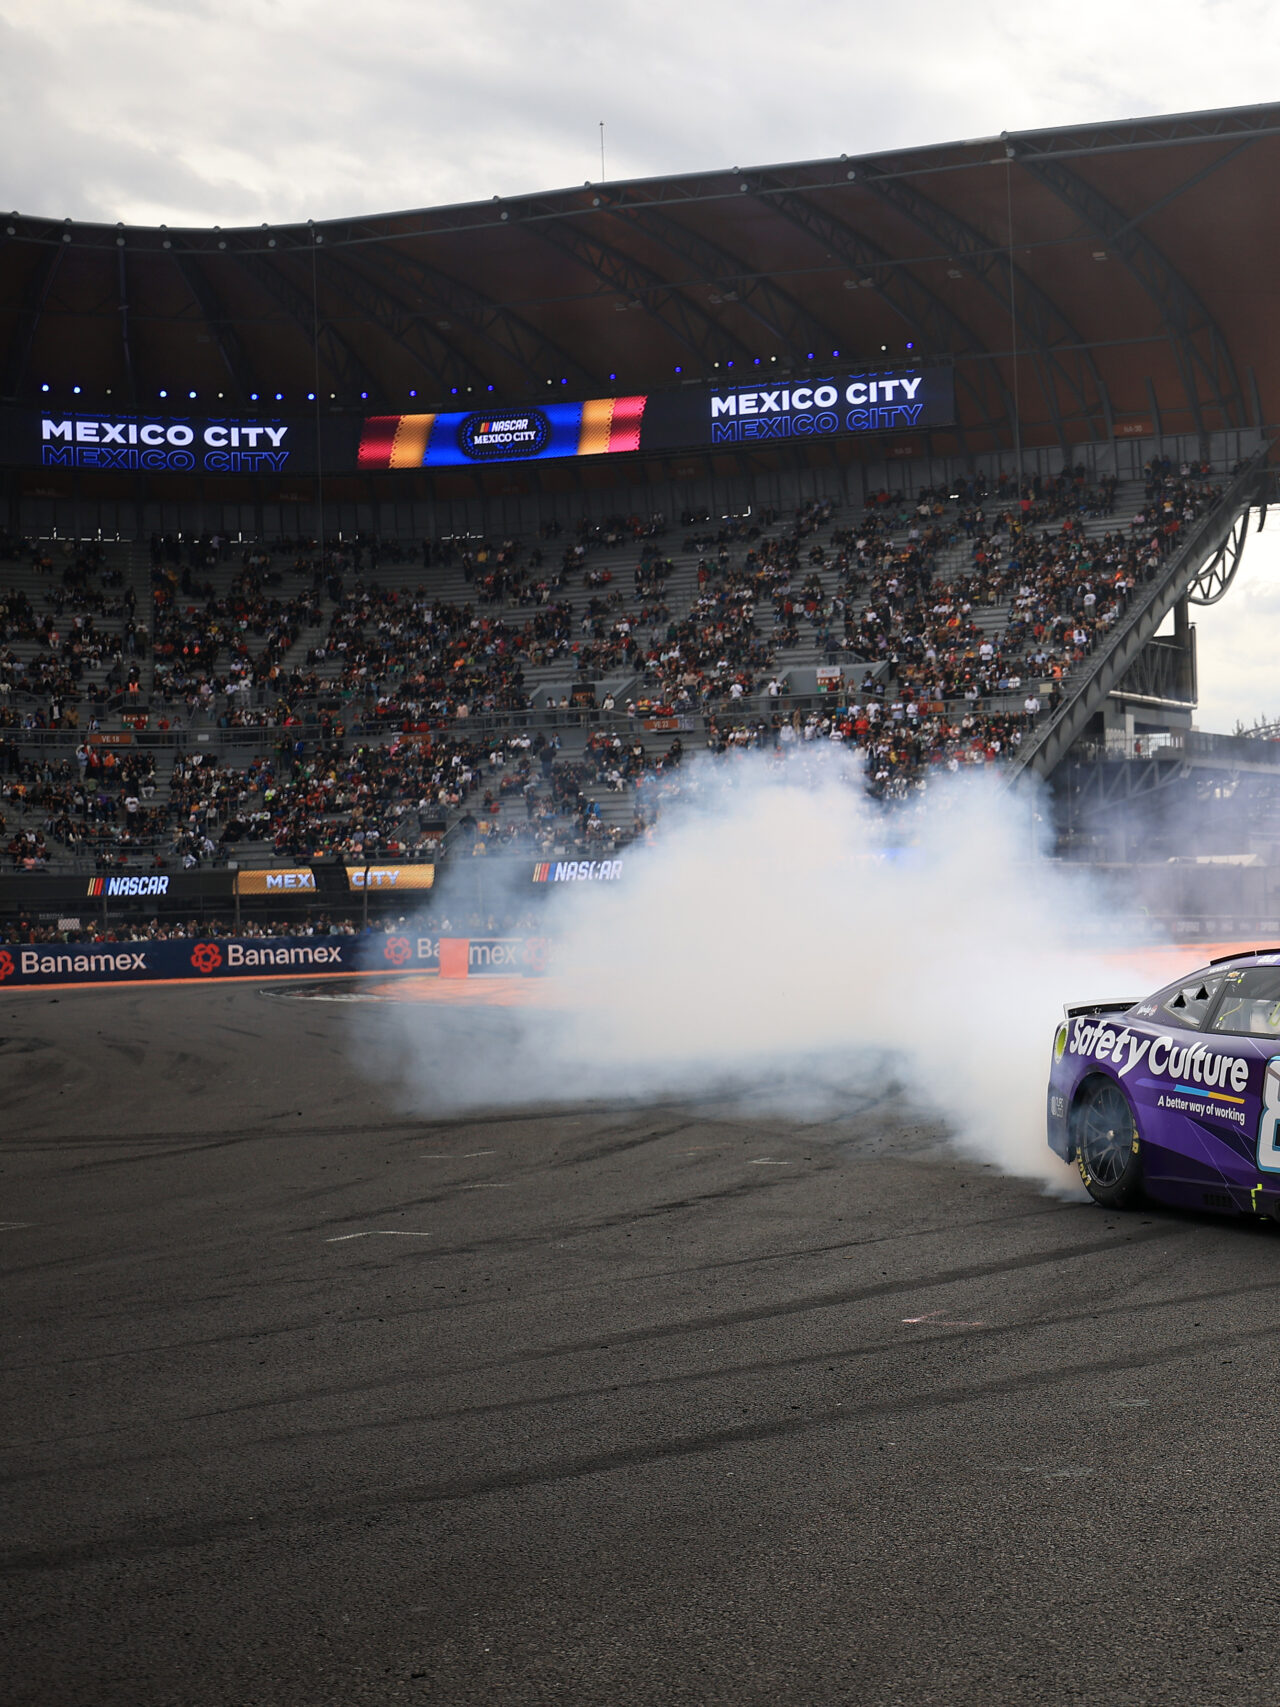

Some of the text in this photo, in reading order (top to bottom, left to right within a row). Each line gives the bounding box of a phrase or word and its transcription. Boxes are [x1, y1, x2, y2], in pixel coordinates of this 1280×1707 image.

[711, 385, 838, 418] MEXICO
[846, 377, 922, 405] CITY
[41, 419, 289, 447] MEXICO CITY
[492, 418, 529, 432] NASCAR
[712, 403, 923, 443] MEXICO CITY
[474, 431, 536, 445] MEXICO CITY
[42, 445, 290, 472] MEXICO CITY
[101, 735, 111, 743] VE
[266, 870, 400, 889] MEXI CITY
[554, 860, 623, 881] NASCAR
[108, 876, 169, 896] NASCAR
[21, 951, 147, 974] Banamex
[228, 944, 342, 967] Banamex
[1069, 1018, 1249, 1092] SafetyCulture
[1157, 1095, 1246, 1126] A better way of working
